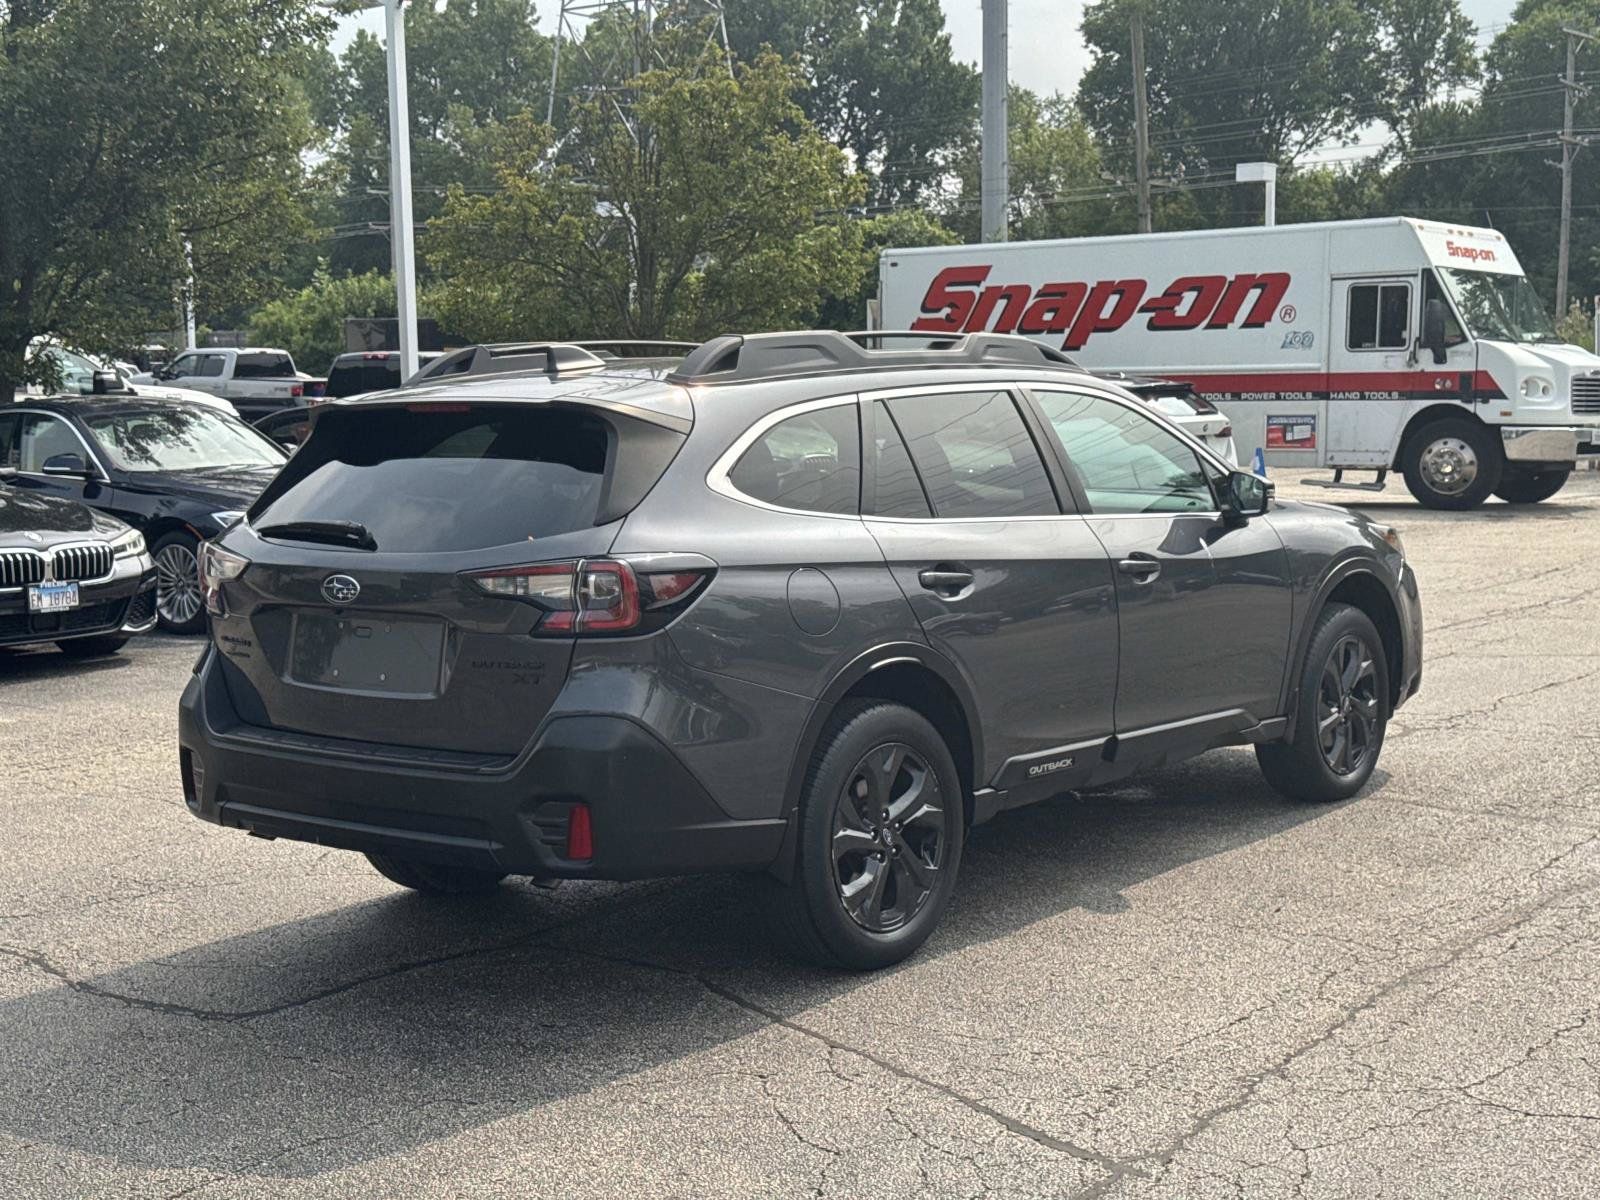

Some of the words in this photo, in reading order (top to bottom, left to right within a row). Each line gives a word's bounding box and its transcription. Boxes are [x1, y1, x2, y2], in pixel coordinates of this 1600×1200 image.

[1446, 240, 1496, 262] Snap-on
[910, 265, 1291, 351] Snap-on
[1241, 392, 1276, 400] POWER
[1330, 391, 1360, 400] HAND
[1029, 758, 1072, 775] OUTBACK
